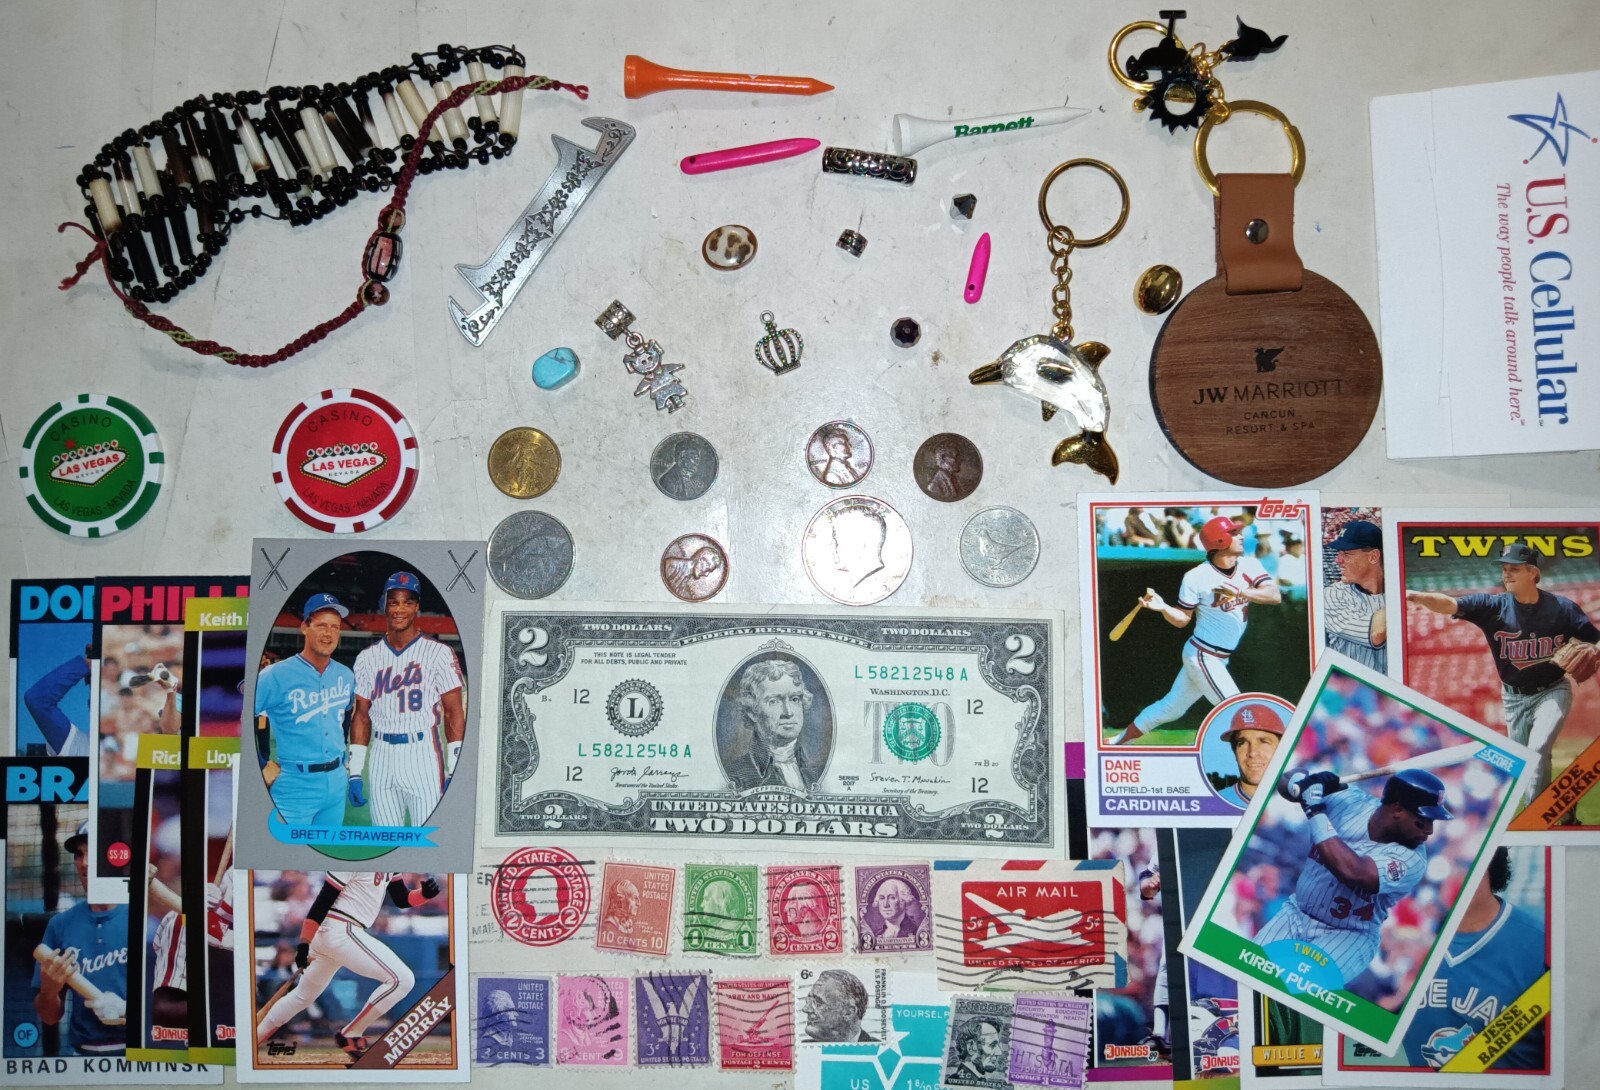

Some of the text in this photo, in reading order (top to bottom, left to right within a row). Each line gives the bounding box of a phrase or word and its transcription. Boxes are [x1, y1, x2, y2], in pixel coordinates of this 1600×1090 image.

[954, 116, 1034, 138] Barnett
[1496, 183, 1511, 208] The
[1496, 213, 1511, 243] way
[1496, 247, 1516, 291] people
[1526, 173, 1577, 424] U.S. Cellular
[1503, 293, 1519, 325] talk
[1505, 328, 1522, 384] around
[1192, 378, 1343, 405] JW MARRIOTT
[50, 414, 112, 442] CASINO
[307, 409, 373, 433] CASINO
[1226, 421, 1316, 435] RESORT & SPA
[59, 453, 120, 477] LAS VEGAS
[312, 456, 377, 472] LAS VEGAS
[53, 479, 136, 517] LAS VEGAS NEVADA
[302, 481, 391, 514] LAS VEGAS NEVADA
[200, 611, 243, 627] Keith
[582, 623, 673, 632] TWO DOLLARS
[881, 627, 971, 637] TWO DOLLARS
[518, 627, 549, 667] 2
[1005, 634, 1037, 675] 2
[371, 660, 423, 701] Mets
[855, 666, 969, 681] L 58212548 A
[397, 688, 423, 713] 18
[573, 688, 590, 704] 12
[626, 697, 644, 718] L
[966, 699, 984, 715] 12
[578, 743, 692, 758] L 58212548 A
[1105, 760, 1141, 771] DANE
[566, 766, 583, 782] 12
[1105, 772, 1140, 783] IORG
[1551, 764, 1584, 799] JOE
[750, 785, 797, 794] JEFFERSON
[971, 777, 989, 793] 12
[1105, 786, 1191, 794] OUTFIELD-1st BASE
[757, 794, 790, 802] THE
[1105, 798, 1200, 812] CARDINALS
[651, 800, 899, 817] UNITED STATES OF AMERICA
[520, 813, 587, 821] TWO DOLLARS
[650, 818, 899, 838] TWO DOLLARS
[983, 822, 1029, 831] DOLLARS
[291, 829, 422, 842] BRETT STRAWBERRY
[109, 849, 129, 860] SS-2B
[517, 852, 558, 865] STATES
[559, 859, 583, 907] POSTAGE
[644, 871, 670, 880] UNITED
[643, 881, 669, 891] STATES
[996, 886, 1079, 898] AIR MAIL
[642, 890, 668, 900] POSTAGE
[564, 909, 577, 925] 2
[1329, 896, 1375, 922] 34
[506, 911, 519, 928] 2
[521, 927, 562, 940] CENTS
[601, 930, 663, 949] 10 CENTS 10
[690, 930, 750, 949] 1 CENT 1
[775, 932, 837, 951] 2 CENTS 2
[863, 934, 872, 949] 3
[920, 931, 929, 947] 3
[1293, 943, 1329, 967] TWINS
[1297, 961, 1312, 973] CF
[517, 983, 544, 992] UNITED
[1238, 948, 1357, 1014] KIRBY PUCKETT
[518, 992, 544, 1001] STATES
[517, 1001, 544, 1010] POSTAGE
[384, 995, 437, 1048] EDDIE
[1482, 1004, 1522, 1044] JESSE
[17, 1030, 33, 1041] OF
[383, 996, 453, 1066] MURRAY
[1477, 1003, 1543, 1065] BARFIELD
[496, 1051, 531, 1060] CENTS
[535, 1047, 545, 1060] 3
[1263, 1048, 1305, 1060] WILLIE
[6, 1059, 68, 1074] BRAD
[851, 1079, 869, 1090] US
